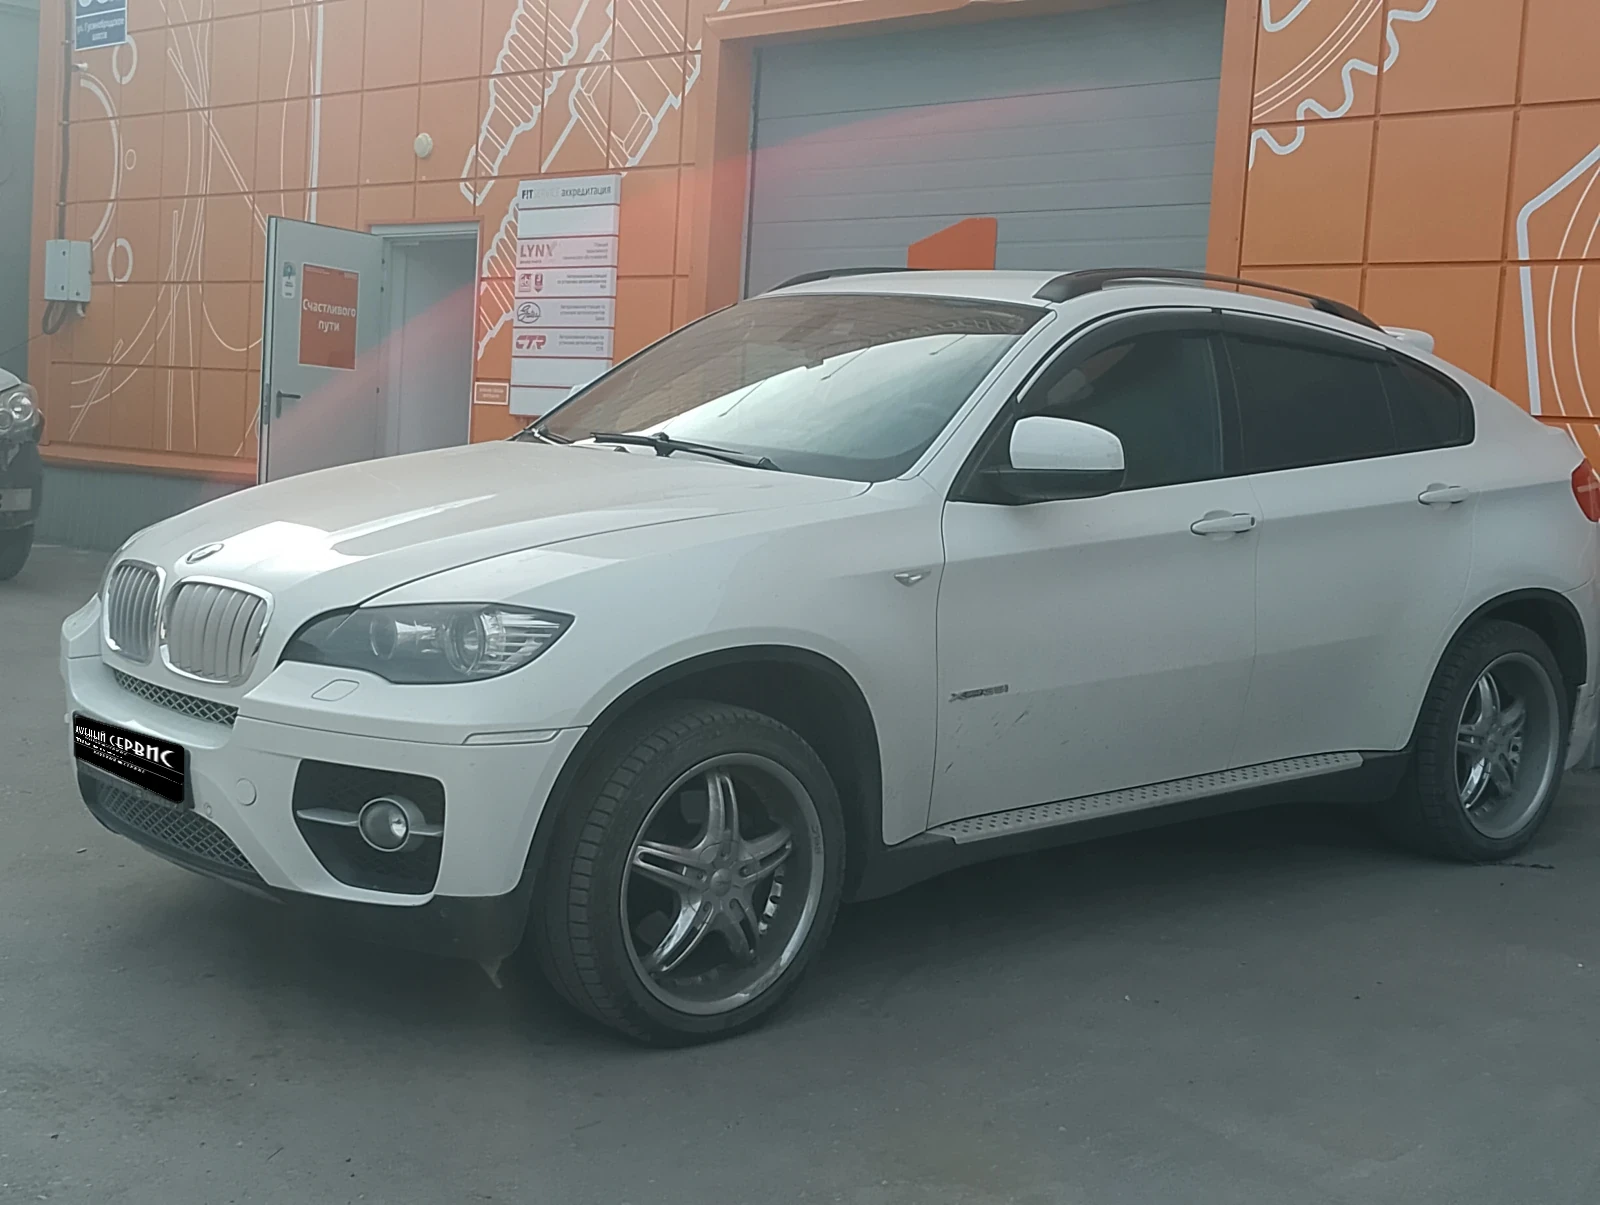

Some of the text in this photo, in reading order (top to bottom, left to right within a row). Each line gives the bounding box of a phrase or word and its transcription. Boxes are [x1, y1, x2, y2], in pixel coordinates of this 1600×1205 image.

[561, 186, 611, 198] аккредитация
[520, 240, 557, 258] LYNX
[303, 298, 357, 318] Счастливого
[318, 320, 340, 333] пути
[516, 335, 546, 350] CTR
